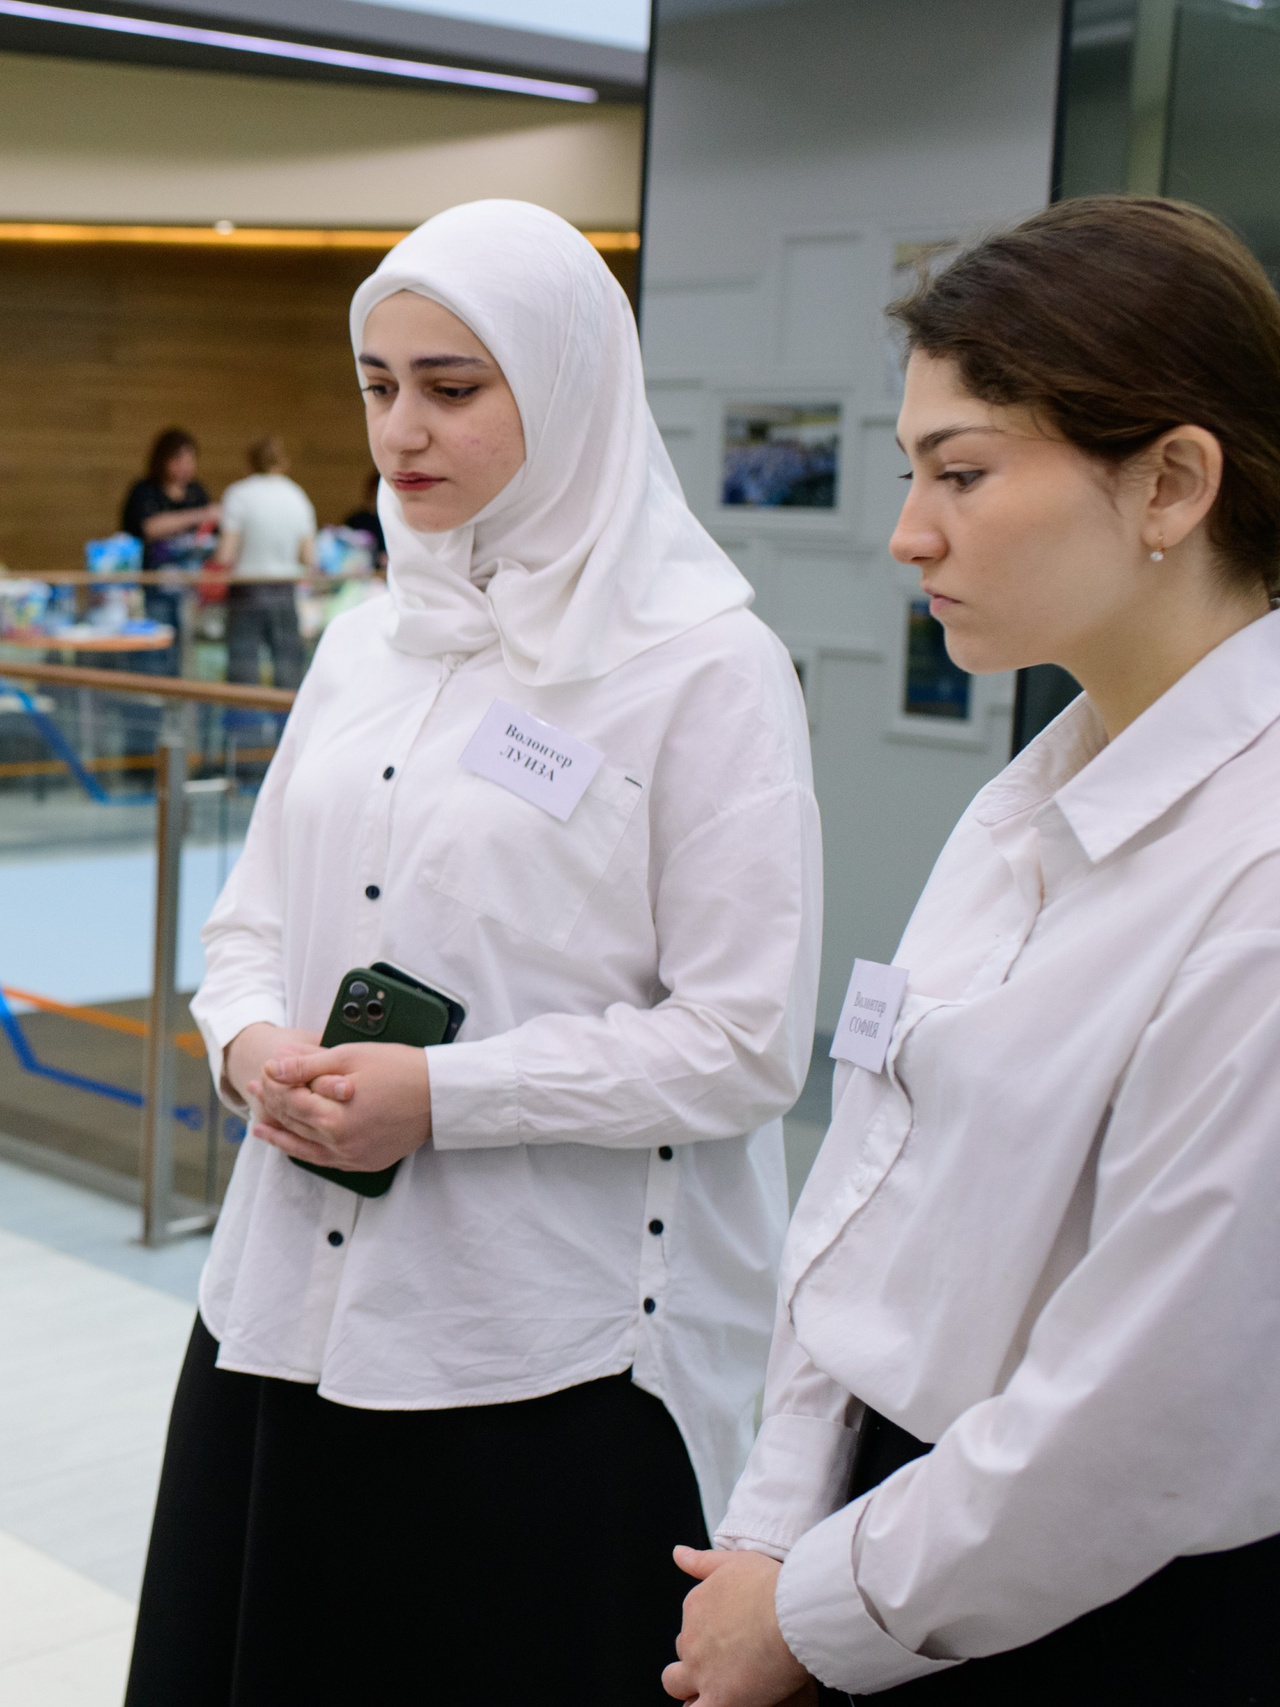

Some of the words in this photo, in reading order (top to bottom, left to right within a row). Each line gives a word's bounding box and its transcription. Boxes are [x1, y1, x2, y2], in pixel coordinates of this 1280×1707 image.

[505, 723, 573, 769] Волонтер
[499, 745, 556, 783] ЛУИЗА
[853, 991, 887, 1018] Волонтер
[848, 1015, 880, 1039] СОФИЯ
